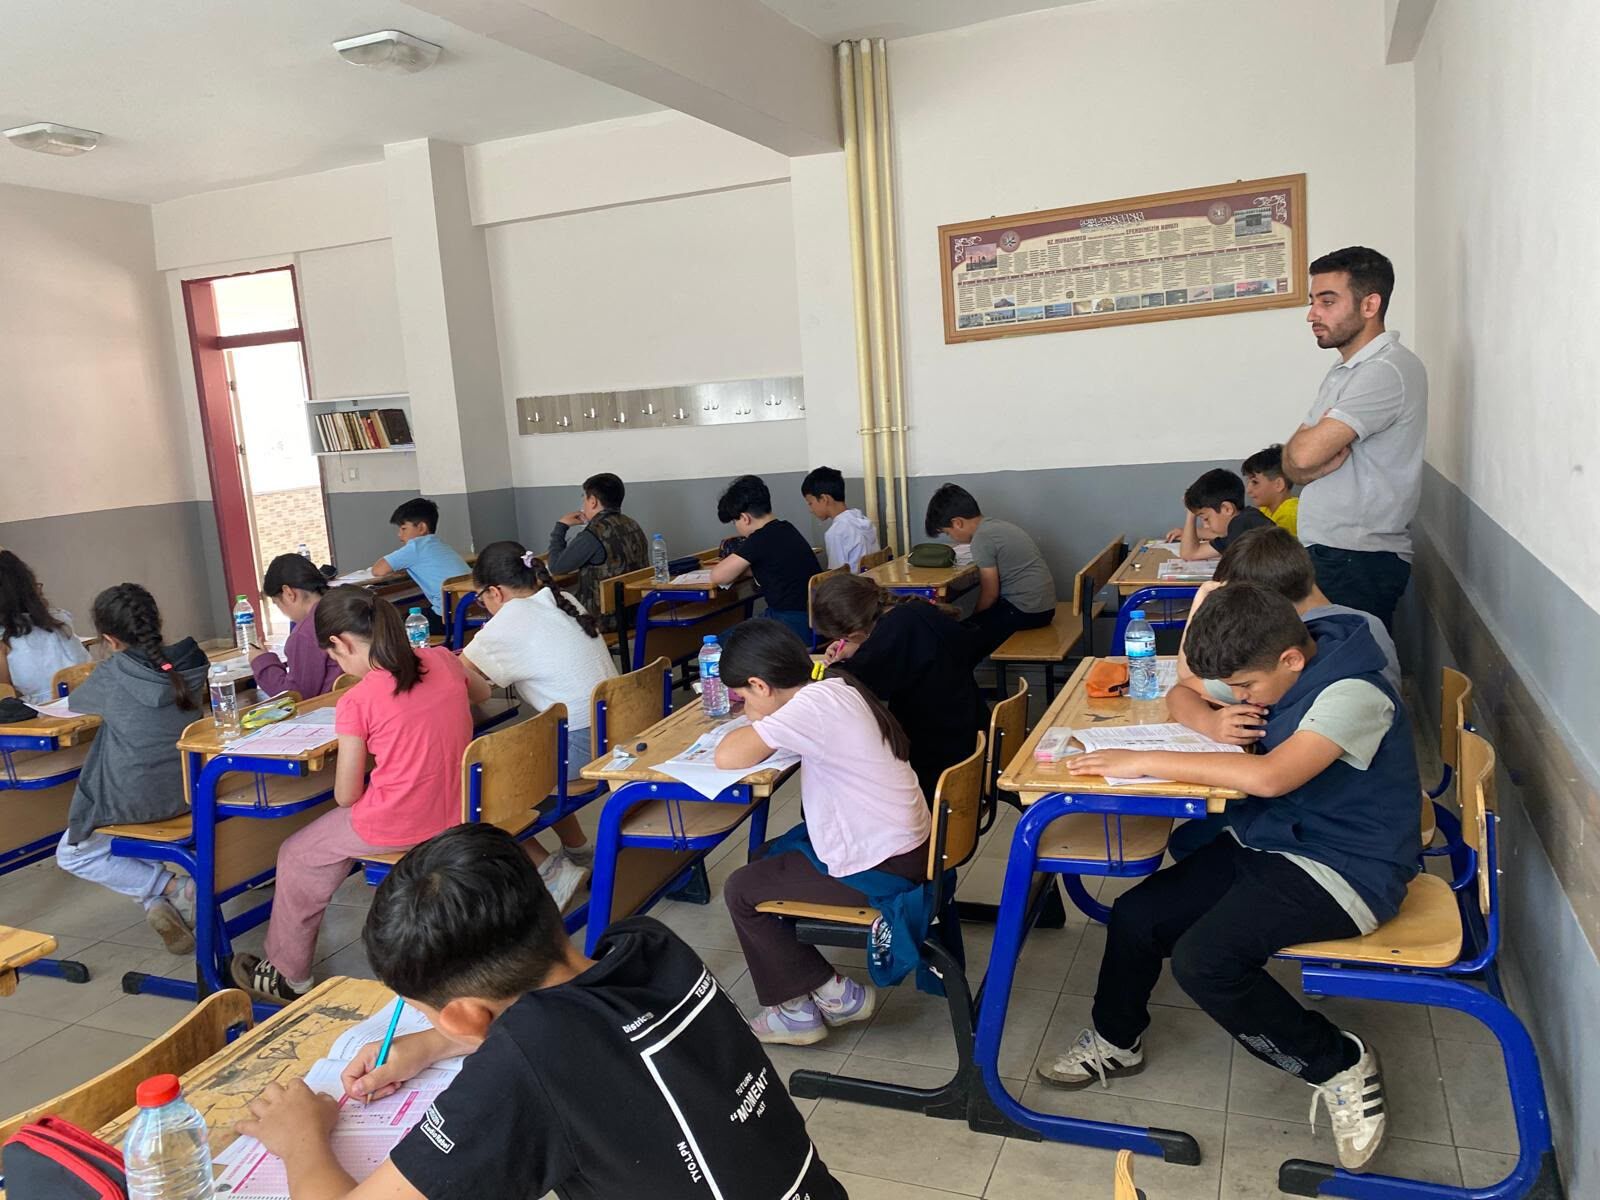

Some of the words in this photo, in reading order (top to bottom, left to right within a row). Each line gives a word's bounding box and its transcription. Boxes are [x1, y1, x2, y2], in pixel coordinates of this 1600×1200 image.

[735, 1072, 754, 1096] FUTURE
[756, 1100, 767, 1118] PAST
[423, 1122, 438, 1138] Audio
[434, 1133, 451, 1150] Rebel
[676, 1141, 702, 1184] TYO.LPN
